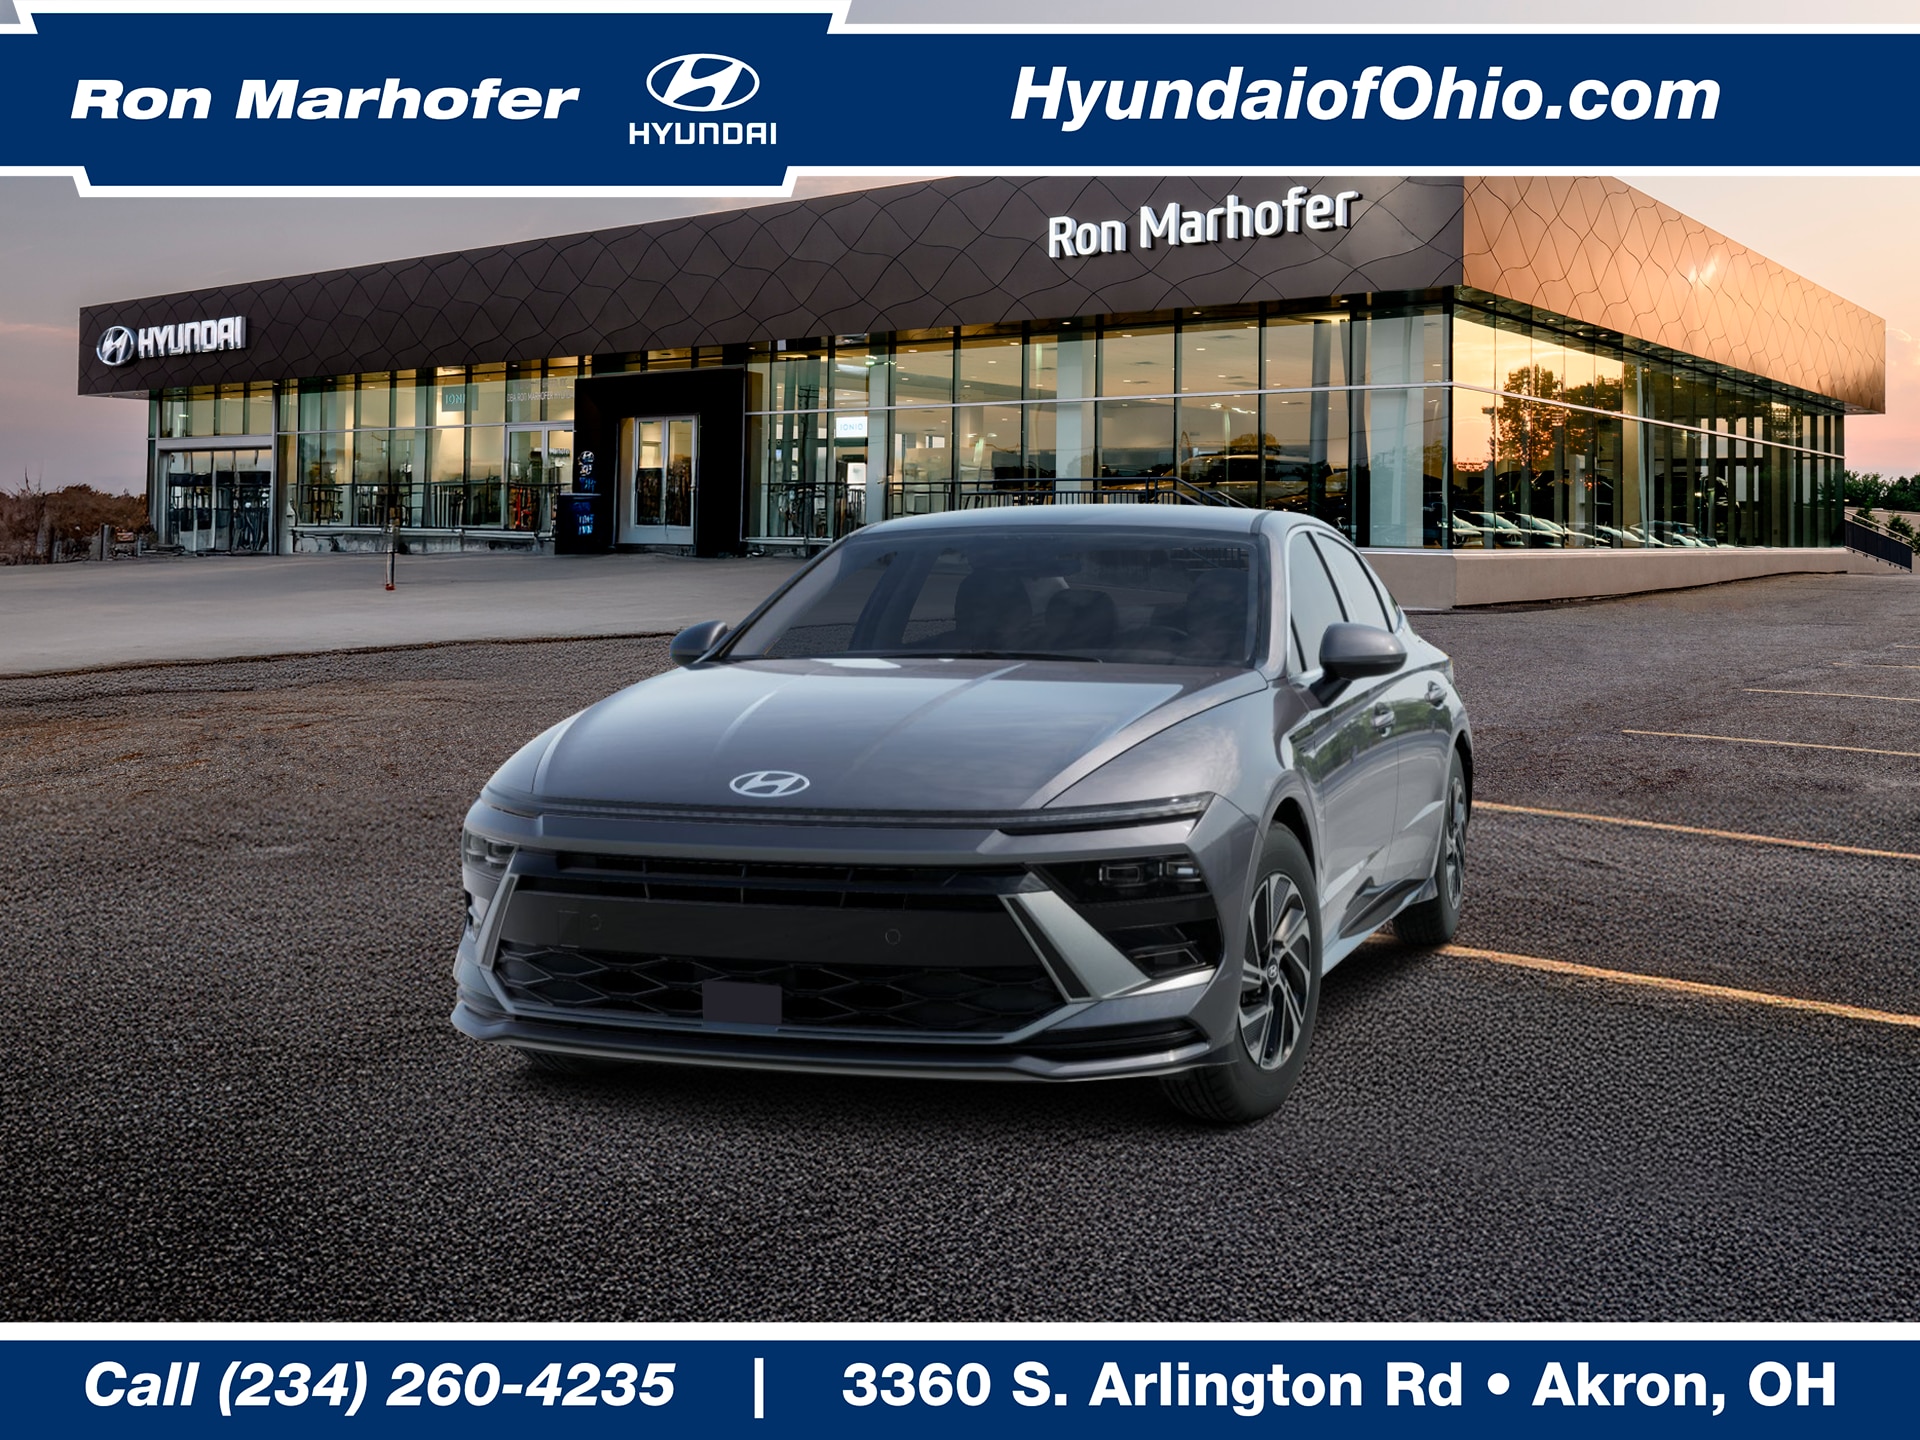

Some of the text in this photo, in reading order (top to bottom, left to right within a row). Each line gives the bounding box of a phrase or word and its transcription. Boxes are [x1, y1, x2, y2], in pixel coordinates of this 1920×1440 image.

[1049, 186, 1359, 259] Ron Marhofer
[138, 316, 246, 358] HYUNDAI
